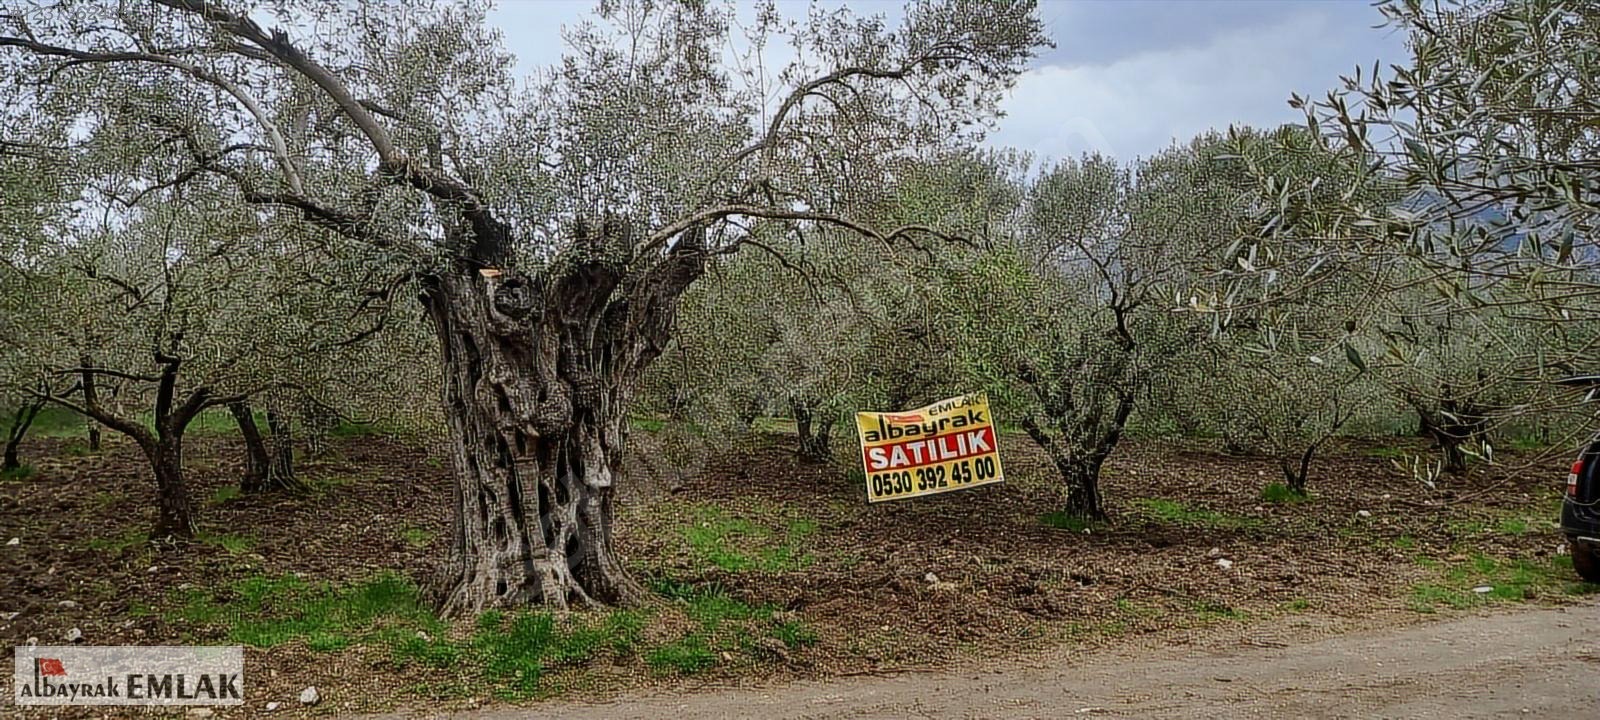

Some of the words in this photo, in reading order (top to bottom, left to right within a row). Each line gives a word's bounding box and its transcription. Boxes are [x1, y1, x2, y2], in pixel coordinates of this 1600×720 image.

[865, 409, 985, 442] albayrak
[869, 429, 992, 470] SATILIK
[872, 472, 912, 496] 0530
[916, 465, 948, 491] 392
[951, 461, 972, 484] 45
[974, 456, 995, 480] 00
